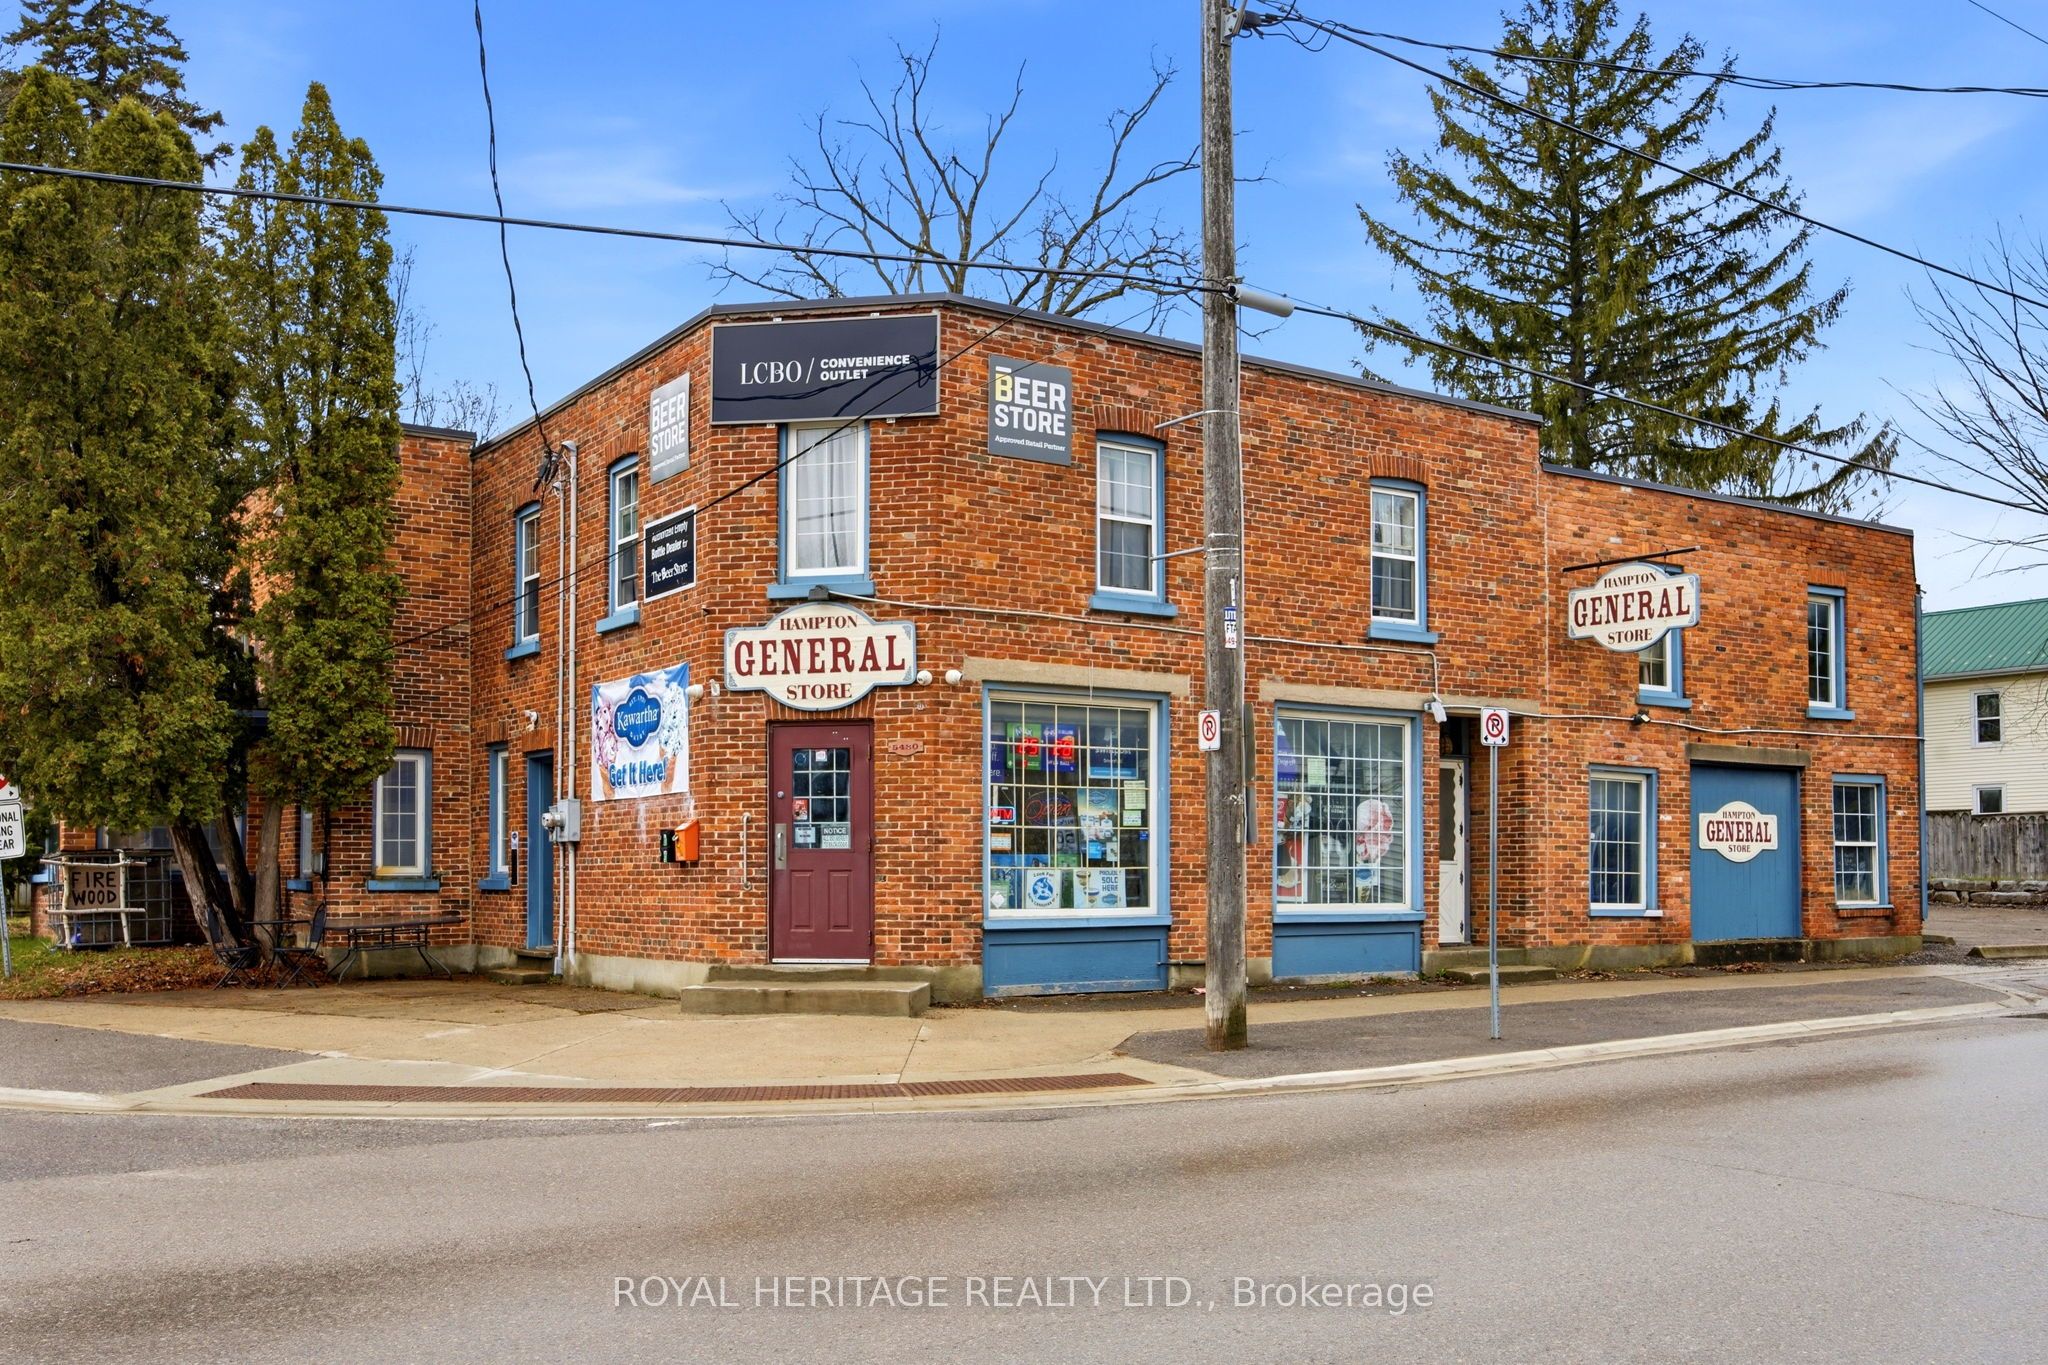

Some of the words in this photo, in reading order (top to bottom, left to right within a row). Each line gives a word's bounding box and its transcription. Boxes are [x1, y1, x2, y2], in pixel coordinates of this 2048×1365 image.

[820, 354, 911, 369] CONVENIENCE
[740, 360, 802, 385] LCBO
[820, 369, 869, 381] OUTLET
[994, 366, 1067, 412] BEER
[652, 391, 687, 433] BEER
[994, 403, 1067, 437] STORE
[651, 420, 686, 456] STORE
[994, 434, 1025, 446] Approved
[1025, 439, 1043, 449] Retail
[1043, 442, 1066, 452] Partner
[651, 570, 662, 583] The
[661, 566, 675, 580] Beer
[673, 562, 688, 576] Store
[1603, 572, 1657, 589] HAMPTON
[1573, 585, 1691, 628] GENERAL
[780, 615, 858, 631] HAMPTON
[1607, 627, 1653, 645] STORE
[734, 635, 906, 676] GENERAL
[786, 683, 853, 700] STORE
[616, 704, 659, 731] Kawartha
[609, 764, 627, 788] Get
[628, 762, 637, 786] It
[639, 756, 669, 784] Here!
[1025, 799, 1073, 820] Open
[1722, 811, 1756, 820] HAMPTON
[0, 825, 13, 837] NG
[823, 827, 847, 835] NOTICE
[1706, 820, 1772, 843] GENERAL
[1727, 844, 1751, 853] STORE
[71, 871, 117, 889] FIRE
[71, 889, 117, 906] WOOD
